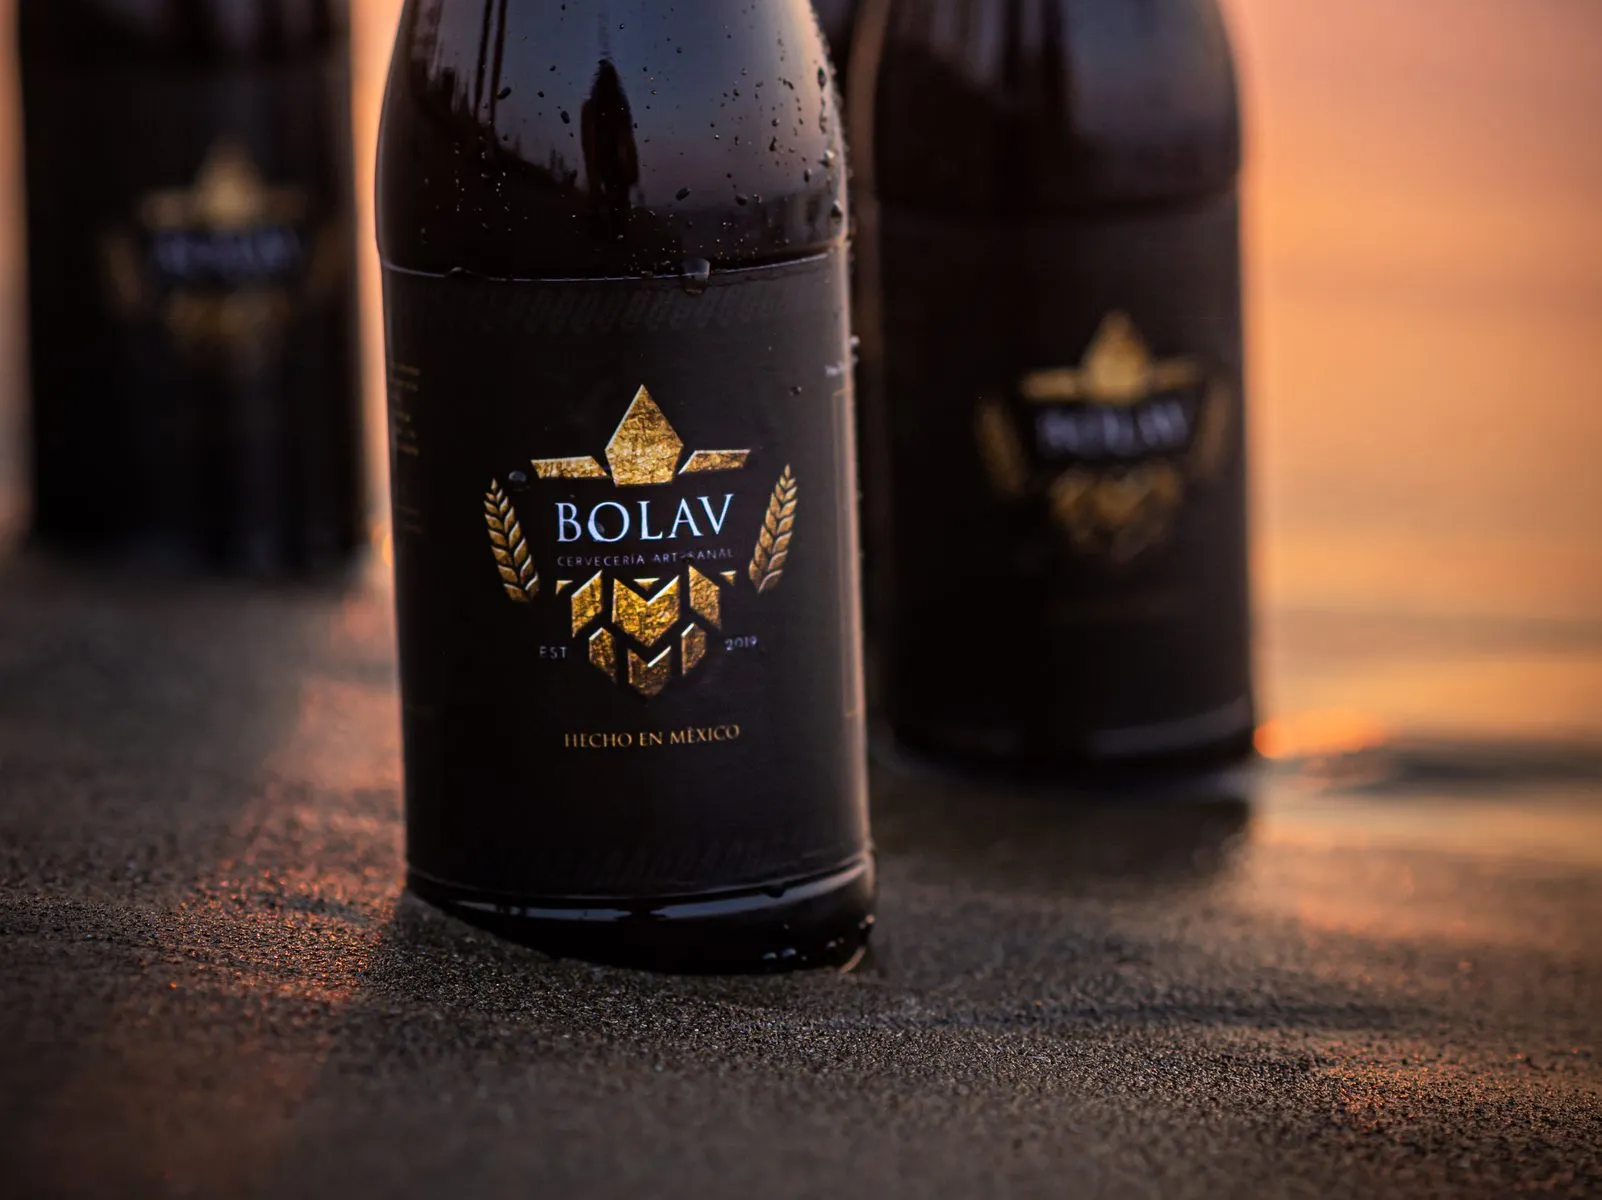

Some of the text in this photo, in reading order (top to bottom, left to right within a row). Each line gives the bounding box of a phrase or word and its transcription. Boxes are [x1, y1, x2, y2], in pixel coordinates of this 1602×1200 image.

[555, 493, 734, 542] BOLAV
[539, 636, 758, 659] EST 2019
[564, 732, 633, 748] HECHO
[639, 731, 663, 746] EN
